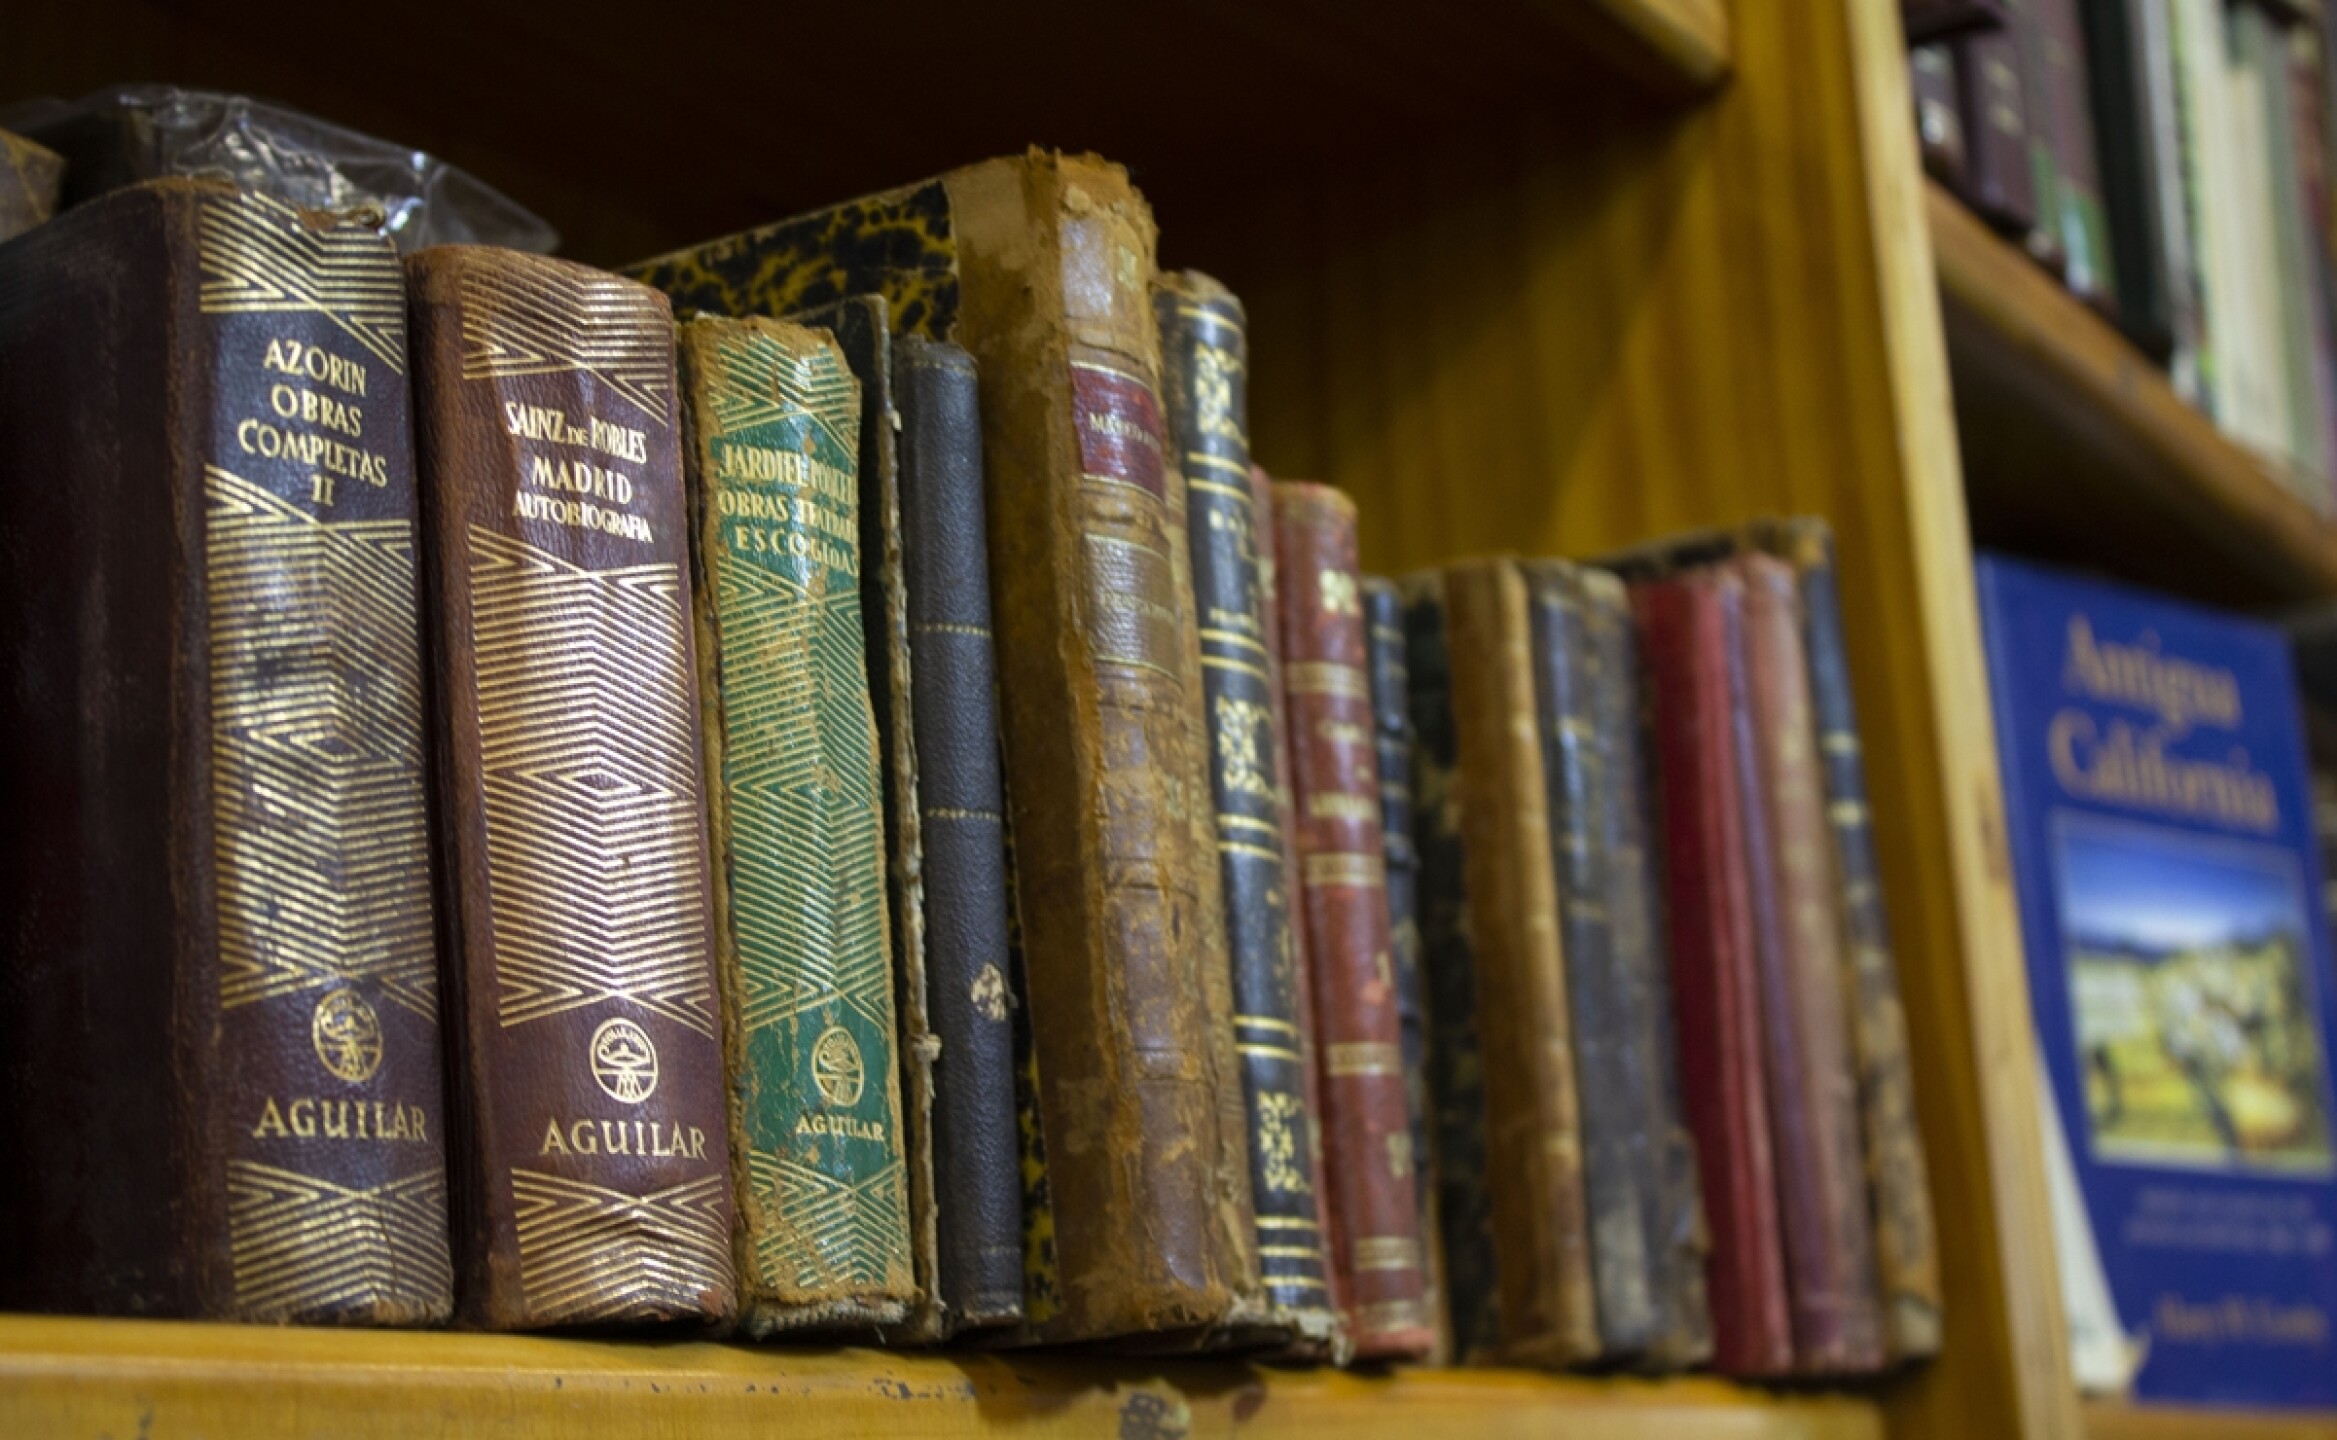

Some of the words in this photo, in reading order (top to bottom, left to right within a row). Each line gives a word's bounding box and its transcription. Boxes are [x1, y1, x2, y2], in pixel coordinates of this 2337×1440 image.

[263, 337, 367, 397] AZORIN
[271, 383, 362, 437] OBRAS
[505, 400, 566, 443] SAINZ
[590, 414, 647, 465] ROBLES
[237, 417, 387, 488] COMPLETAS
[719, 443, 808, 487] JARDIEL
[311, 473, 336, 507] II
[531, 454, 633, 504] MADRID
[513, 489, 654, 544] AUTOBIOGRAFIA
[717, 490, 790, 522] OBRAS
[252, 1095, 428, 1142] AGUILAR
[539, 1116, 708, 1161] AGUILAR
[796, 1113, 886, 1142] AGUILAR
